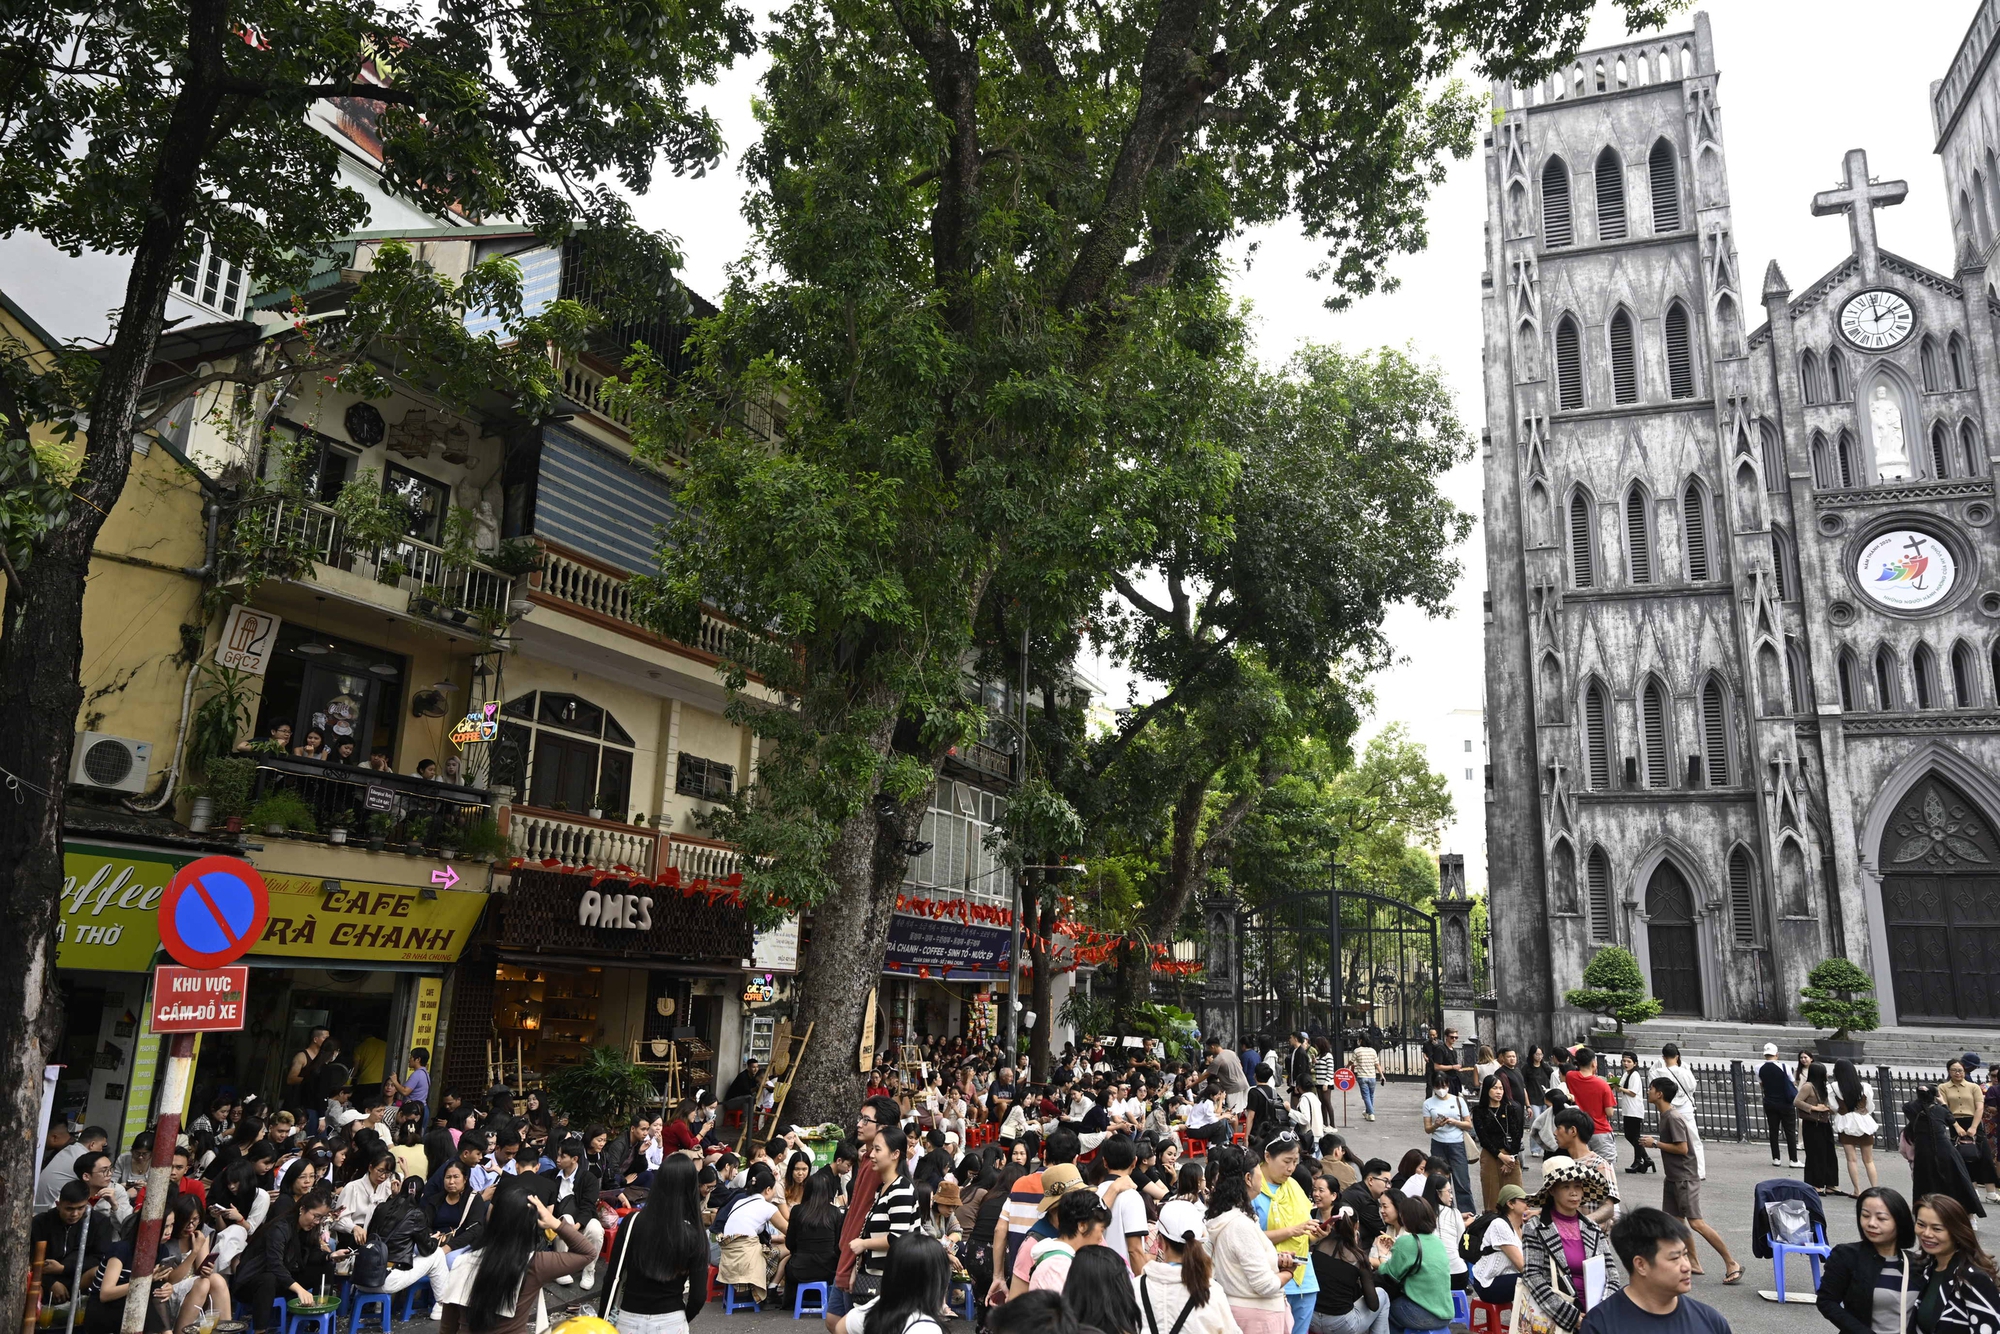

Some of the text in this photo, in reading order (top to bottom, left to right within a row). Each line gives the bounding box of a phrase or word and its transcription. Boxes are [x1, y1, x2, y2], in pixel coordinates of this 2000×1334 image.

[1867, 545, 1880, 558] THÁNH
[1879, 538, 1892, 547] 2025
[1930, 545, 1942, 557] VỌNG
[1936, 576, 1947, 592] HƯƠNG
[1883, 595, 1903, 604] NHỮNG
[1923, 591, 1936, 601] HÀNH
[475, 722, 482, 732] 2
[453, 732, 480, 742] COFFEE
[60, 863, 163, 916] offee
[293, 880, 318, 894] Thu
[320, 889, 416, 918] CAFE
[579, 890, 654, 931] AMES
[74, 922, 125, 945] THỜ
[261, 914, 456, 950] RÀ CHANH
[412, 952, 427, 960] NHÀ
[428, 953, 452, 961] CHUNG
[897, 943, 919, 954] CHANH
[922, 946, 945, 956] COFFEE
[947, 949, 961, 958] SINH
[961, 947, 970, 958] TỐ
[971, 950, 987, 959] NƯỚC
[986, 950, 994, 960] ÉP
[172, 976, 232, 995] KHU VỰC
[426, 988, 434, 996] CAFE
[744, 993, 763, 1001] COFFEE
[160, 1000, 237, 1021] CẤM ĐỖ XE
